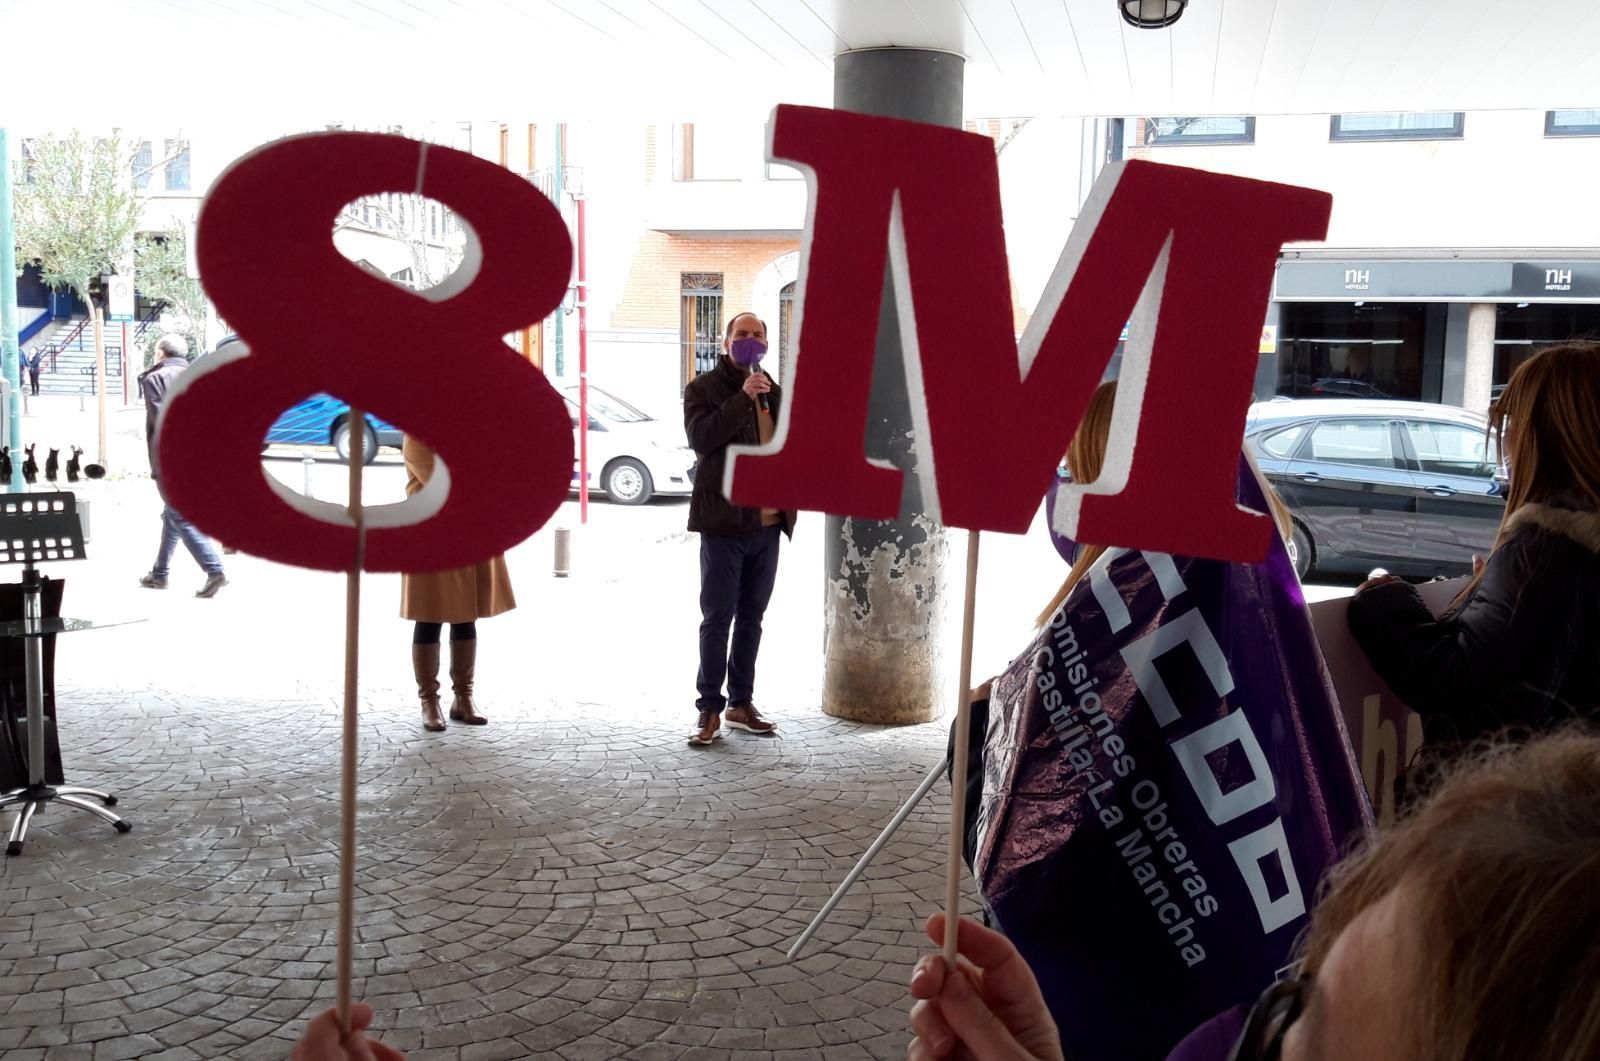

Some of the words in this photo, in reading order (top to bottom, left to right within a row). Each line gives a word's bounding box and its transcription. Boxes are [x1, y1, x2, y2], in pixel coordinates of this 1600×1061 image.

[1050, 608, 1136, 778] omisiones
[1131, 779, 1219, 918] Obreras
[1115, 828, 1206, 969] Mancha
